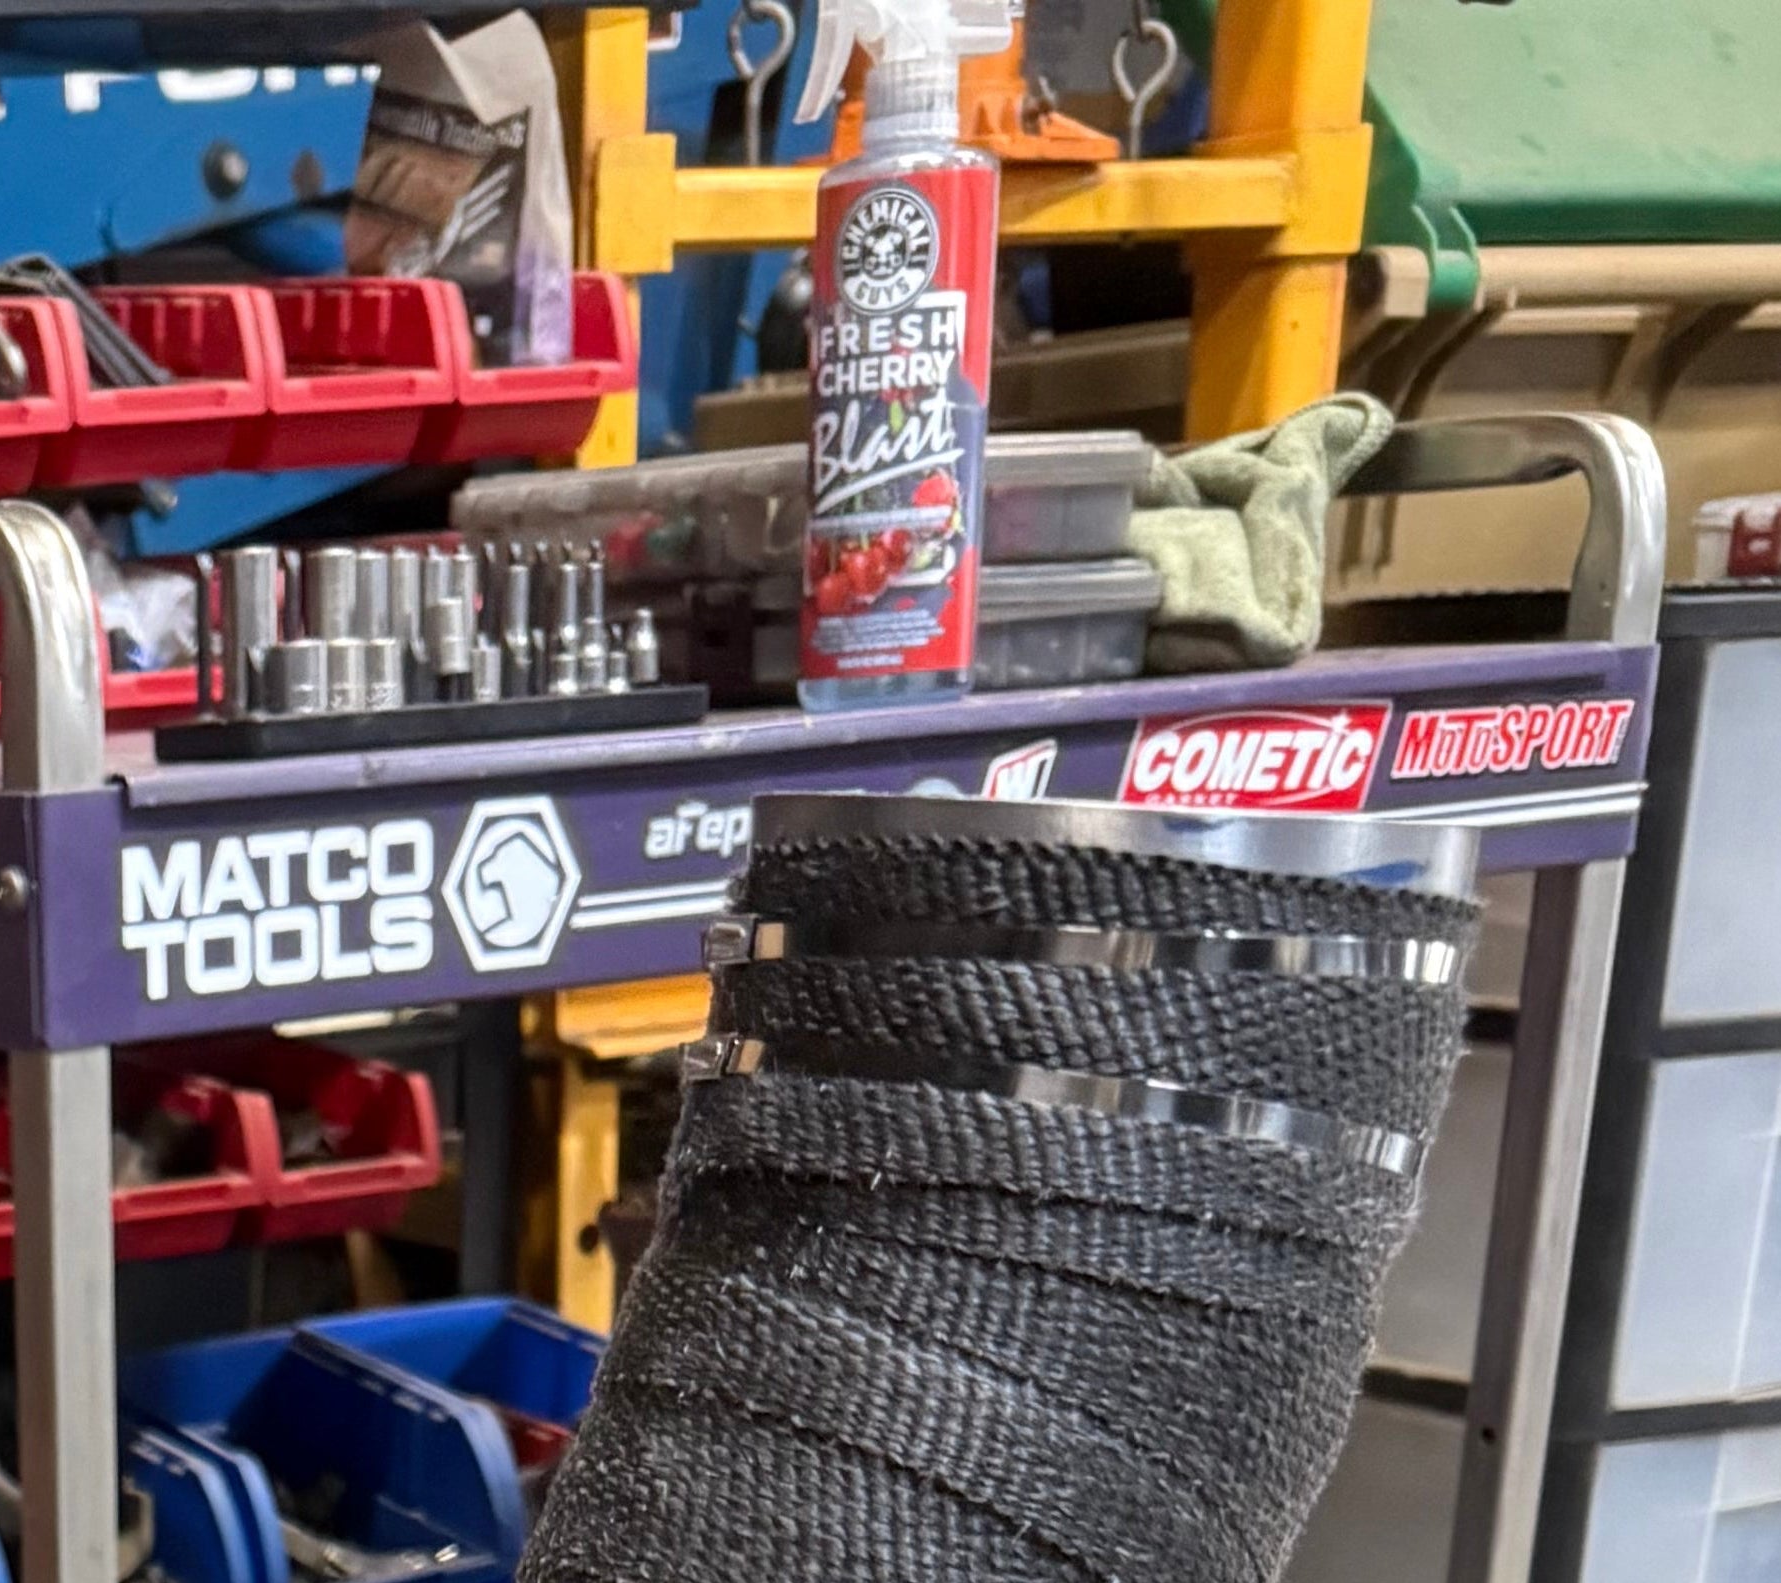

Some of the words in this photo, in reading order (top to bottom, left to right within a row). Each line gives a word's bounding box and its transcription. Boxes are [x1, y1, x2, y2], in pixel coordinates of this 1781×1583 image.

[842, 199, 930, 260] CHEMICAL
[854, 277, 911, 304] GUYS
[818, 311, 955, 358] FRESH
[817, 350, 955, 396] CHERRY
[813, 387, 957, 495] Blast
[1132, 718, 1375, 793] COMETIC
[121, 818, 434, 923] MATCO
[121, 895, 434, 1001] TOOLS
